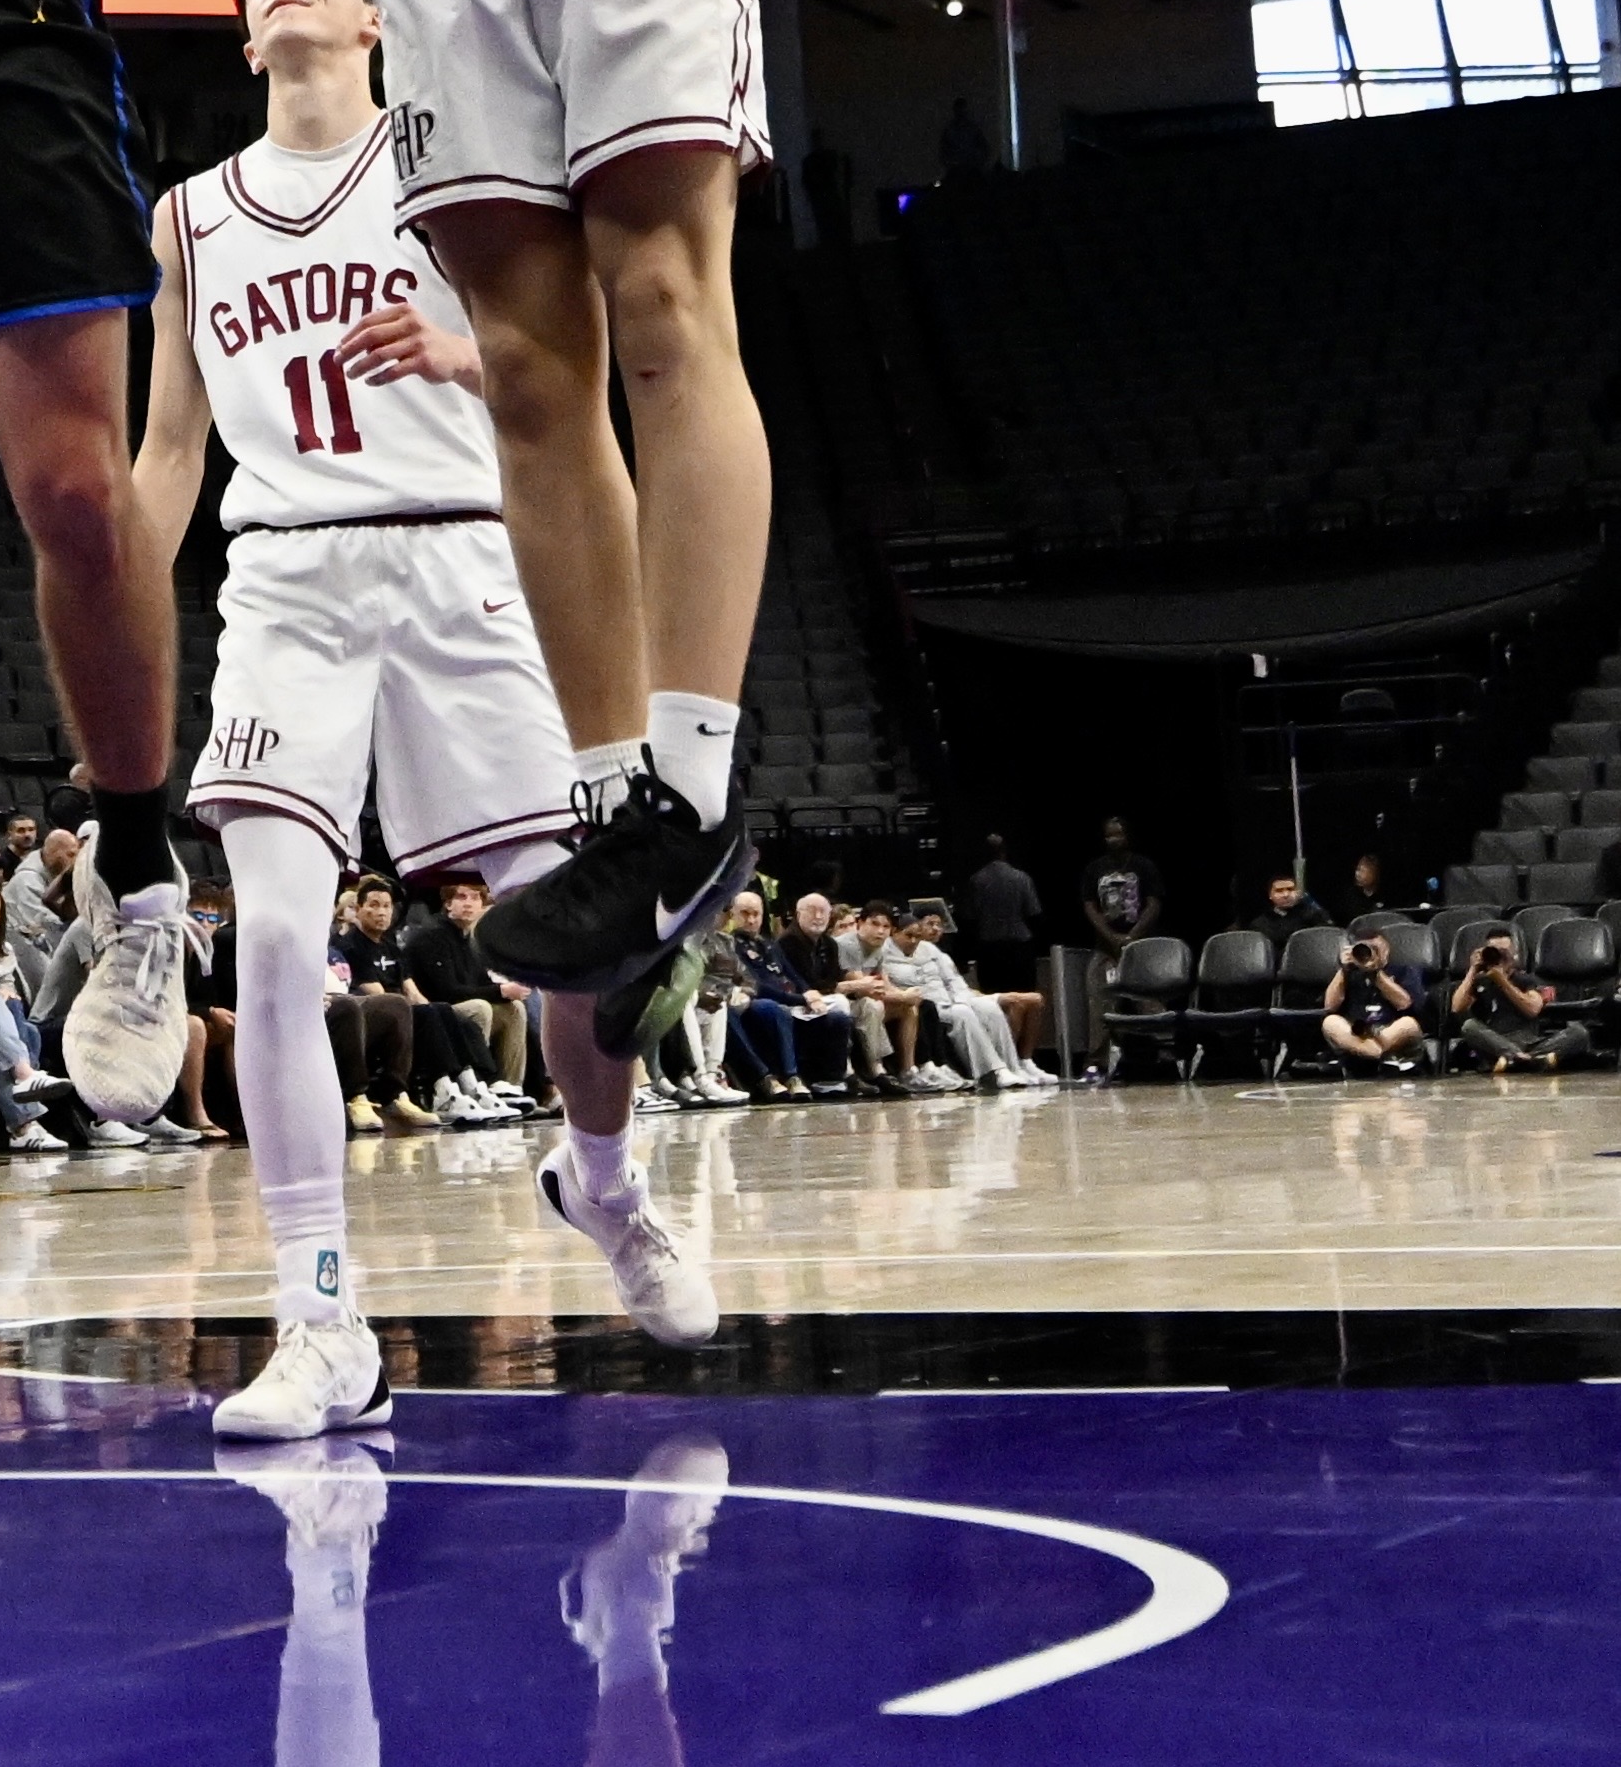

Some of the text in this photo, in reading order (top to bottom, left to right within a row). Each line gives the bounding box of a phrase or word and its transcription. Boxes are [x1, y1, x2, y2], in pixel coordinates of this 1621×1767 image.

[388, 100, 436, 182] HP
[283, 348, 364, 456] 11
[208, 716, 281, 771] SHP
